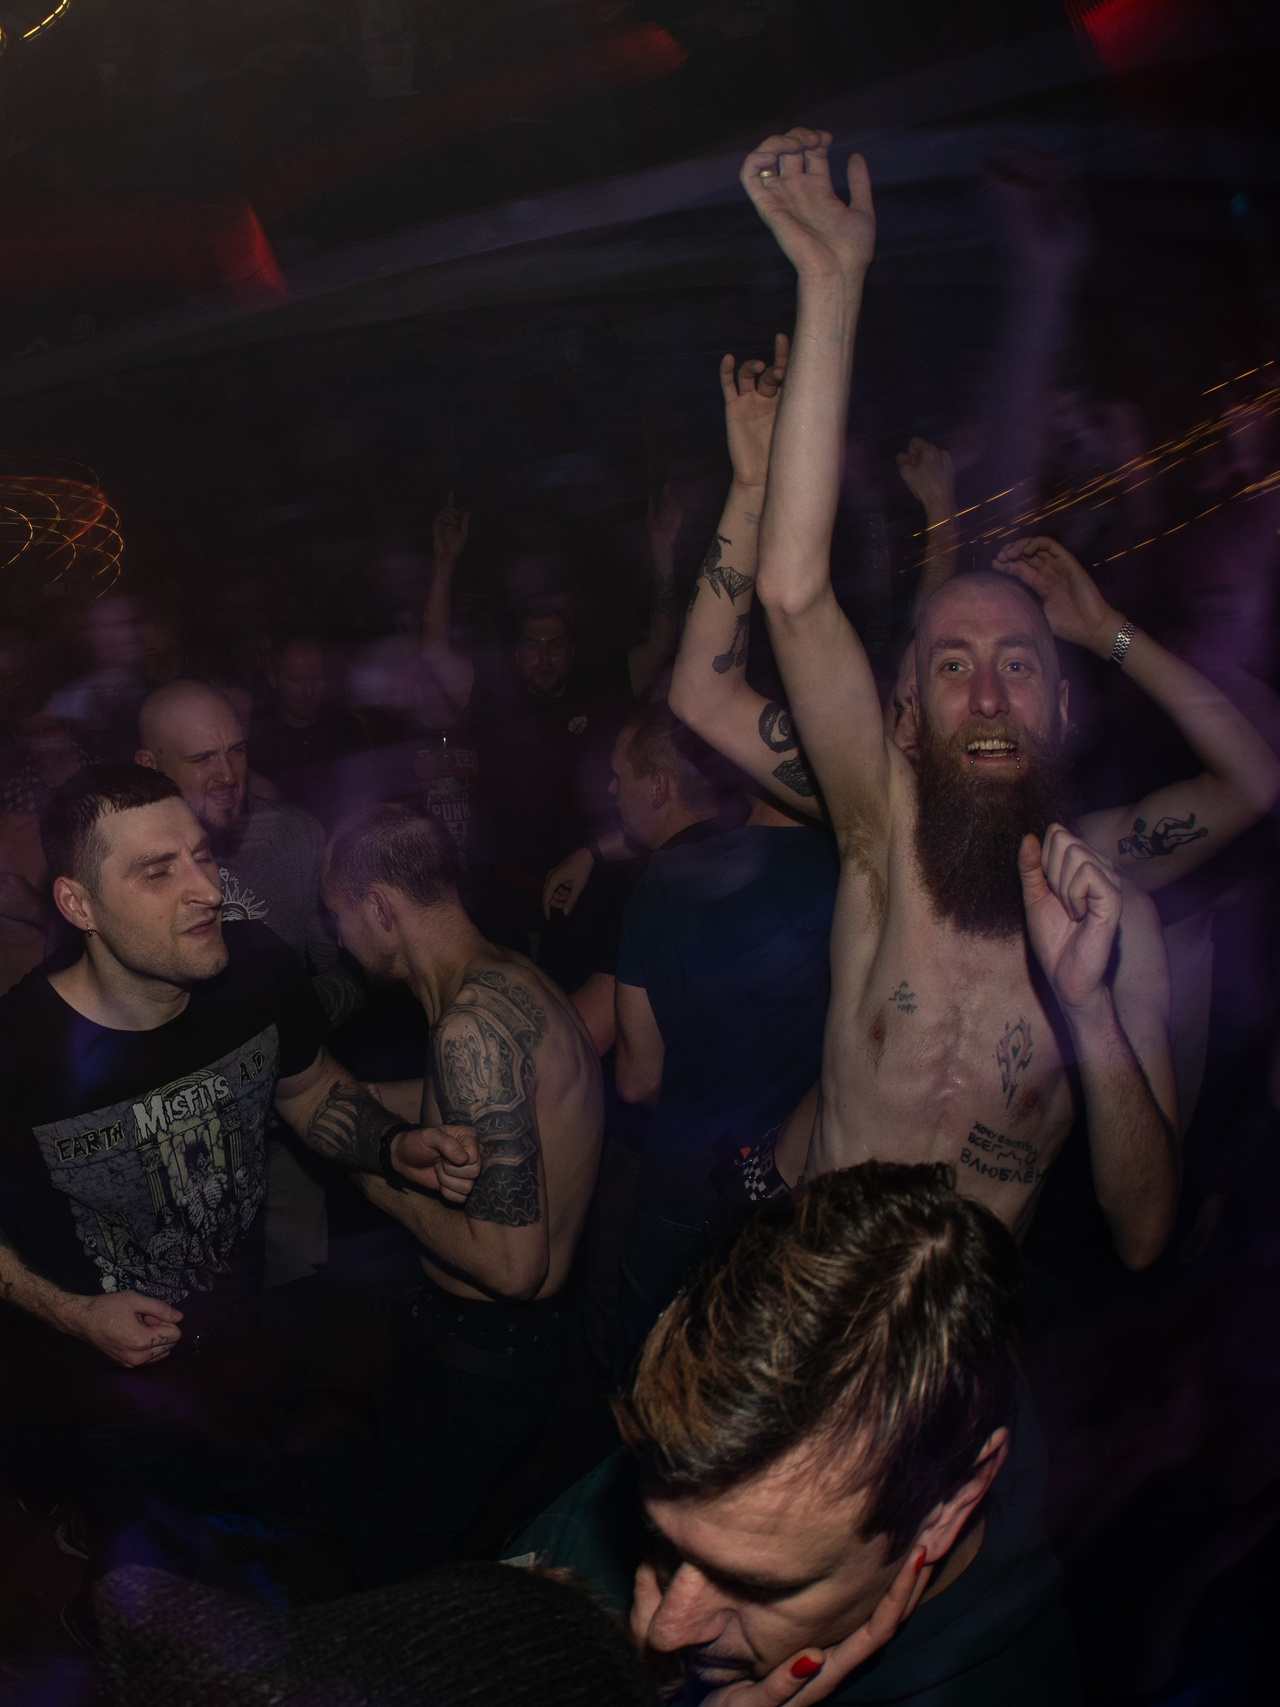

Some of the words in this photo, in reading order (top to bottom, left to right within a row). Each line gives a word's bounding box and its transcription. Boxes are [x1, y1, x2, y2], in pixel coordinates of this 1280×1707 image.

[431, 800, 471, 821] PUNK
[131, 1074, 231, 1141] MISFITS
[54, 1119, 125, 1164] EARTH
